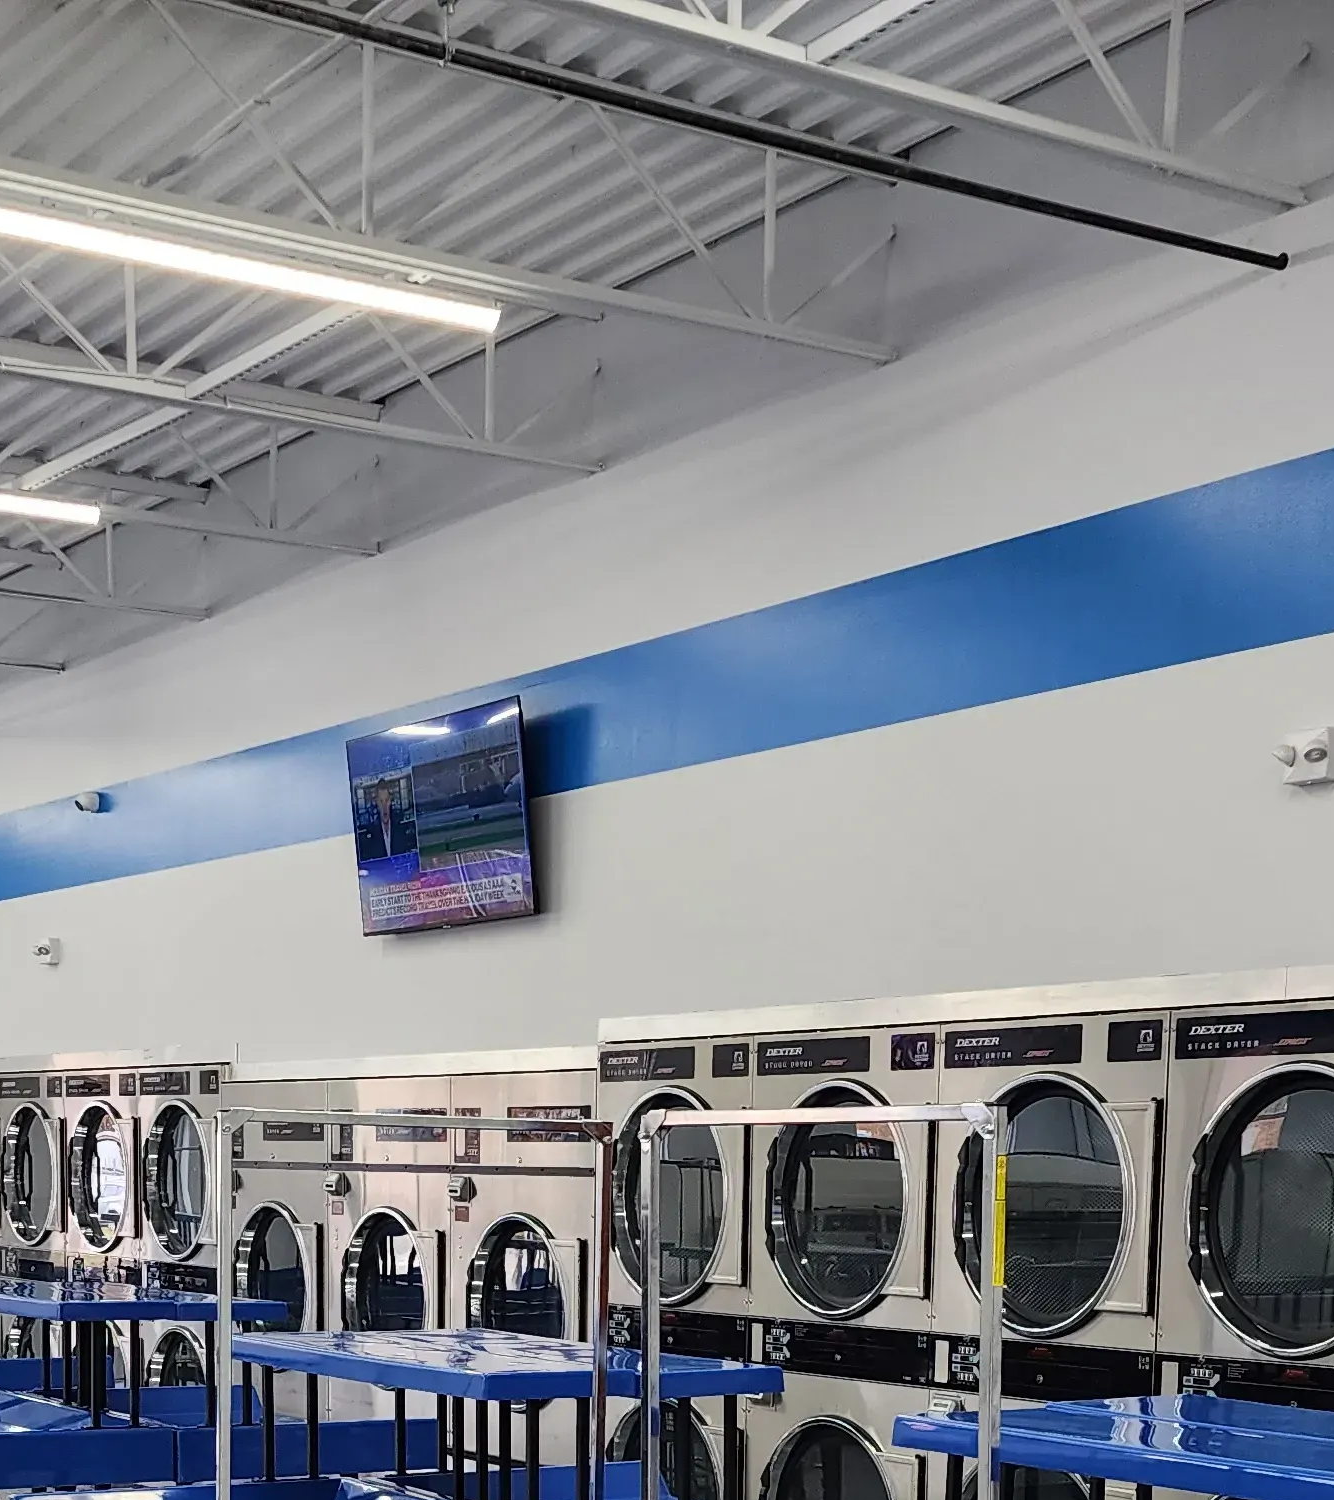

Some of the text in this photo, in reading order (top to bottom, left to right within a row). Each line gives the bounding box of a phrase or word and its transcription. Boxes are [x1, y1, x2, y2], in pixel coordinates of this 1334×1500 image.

[387, 894, 404, 907] START
[1189, 1023, 1245, 1035] DEXTER
[955, 1037, 1000, 1047] DEXTER
[1187, 1042, 1220, 1050] STACK
[766, 1047, 803, 1057] DEXTER
